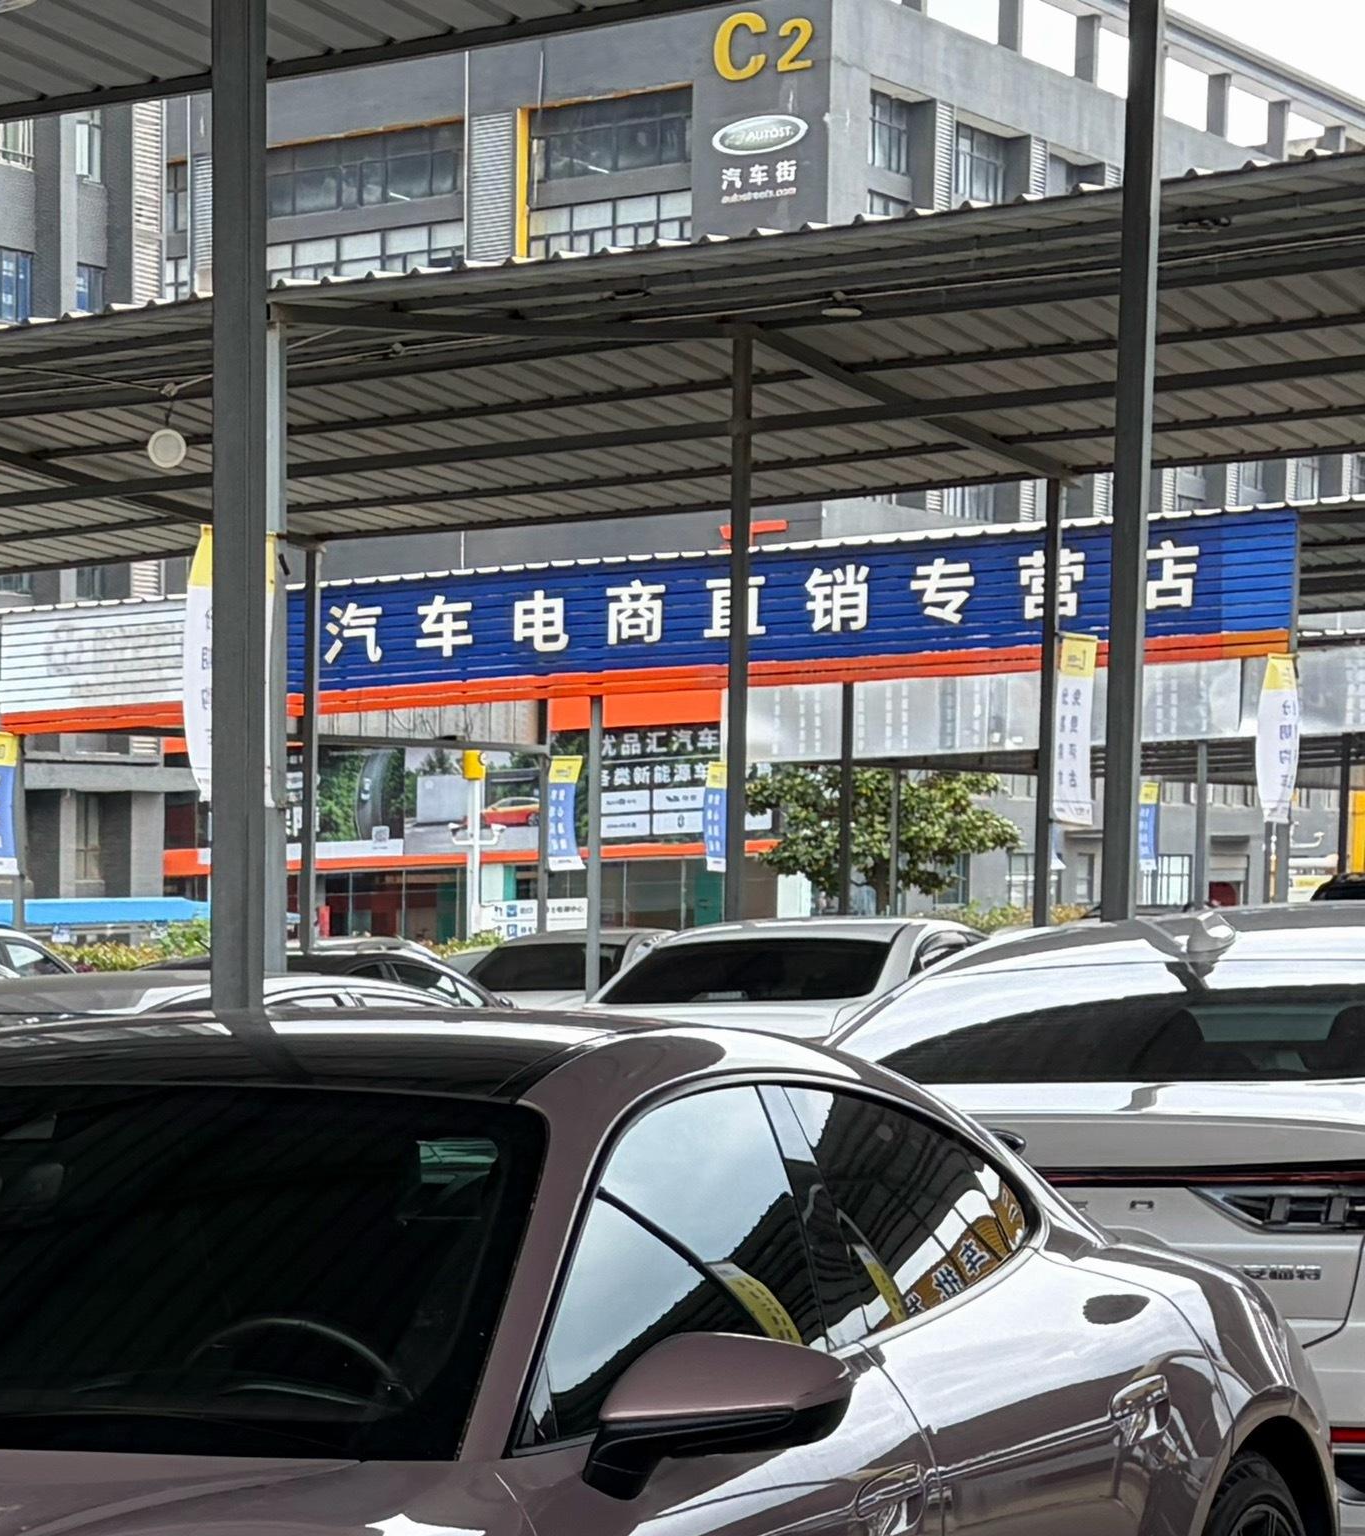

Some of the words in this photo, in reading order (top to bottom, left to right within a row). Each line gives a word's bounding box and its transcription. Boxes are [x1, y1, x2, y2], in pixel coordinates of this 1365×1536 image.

[713, 12, 813, 81] C2
[721, 160, 798, 190] 汽车街
[324, 540, 1200, 664] 汽车电商直销专营店
